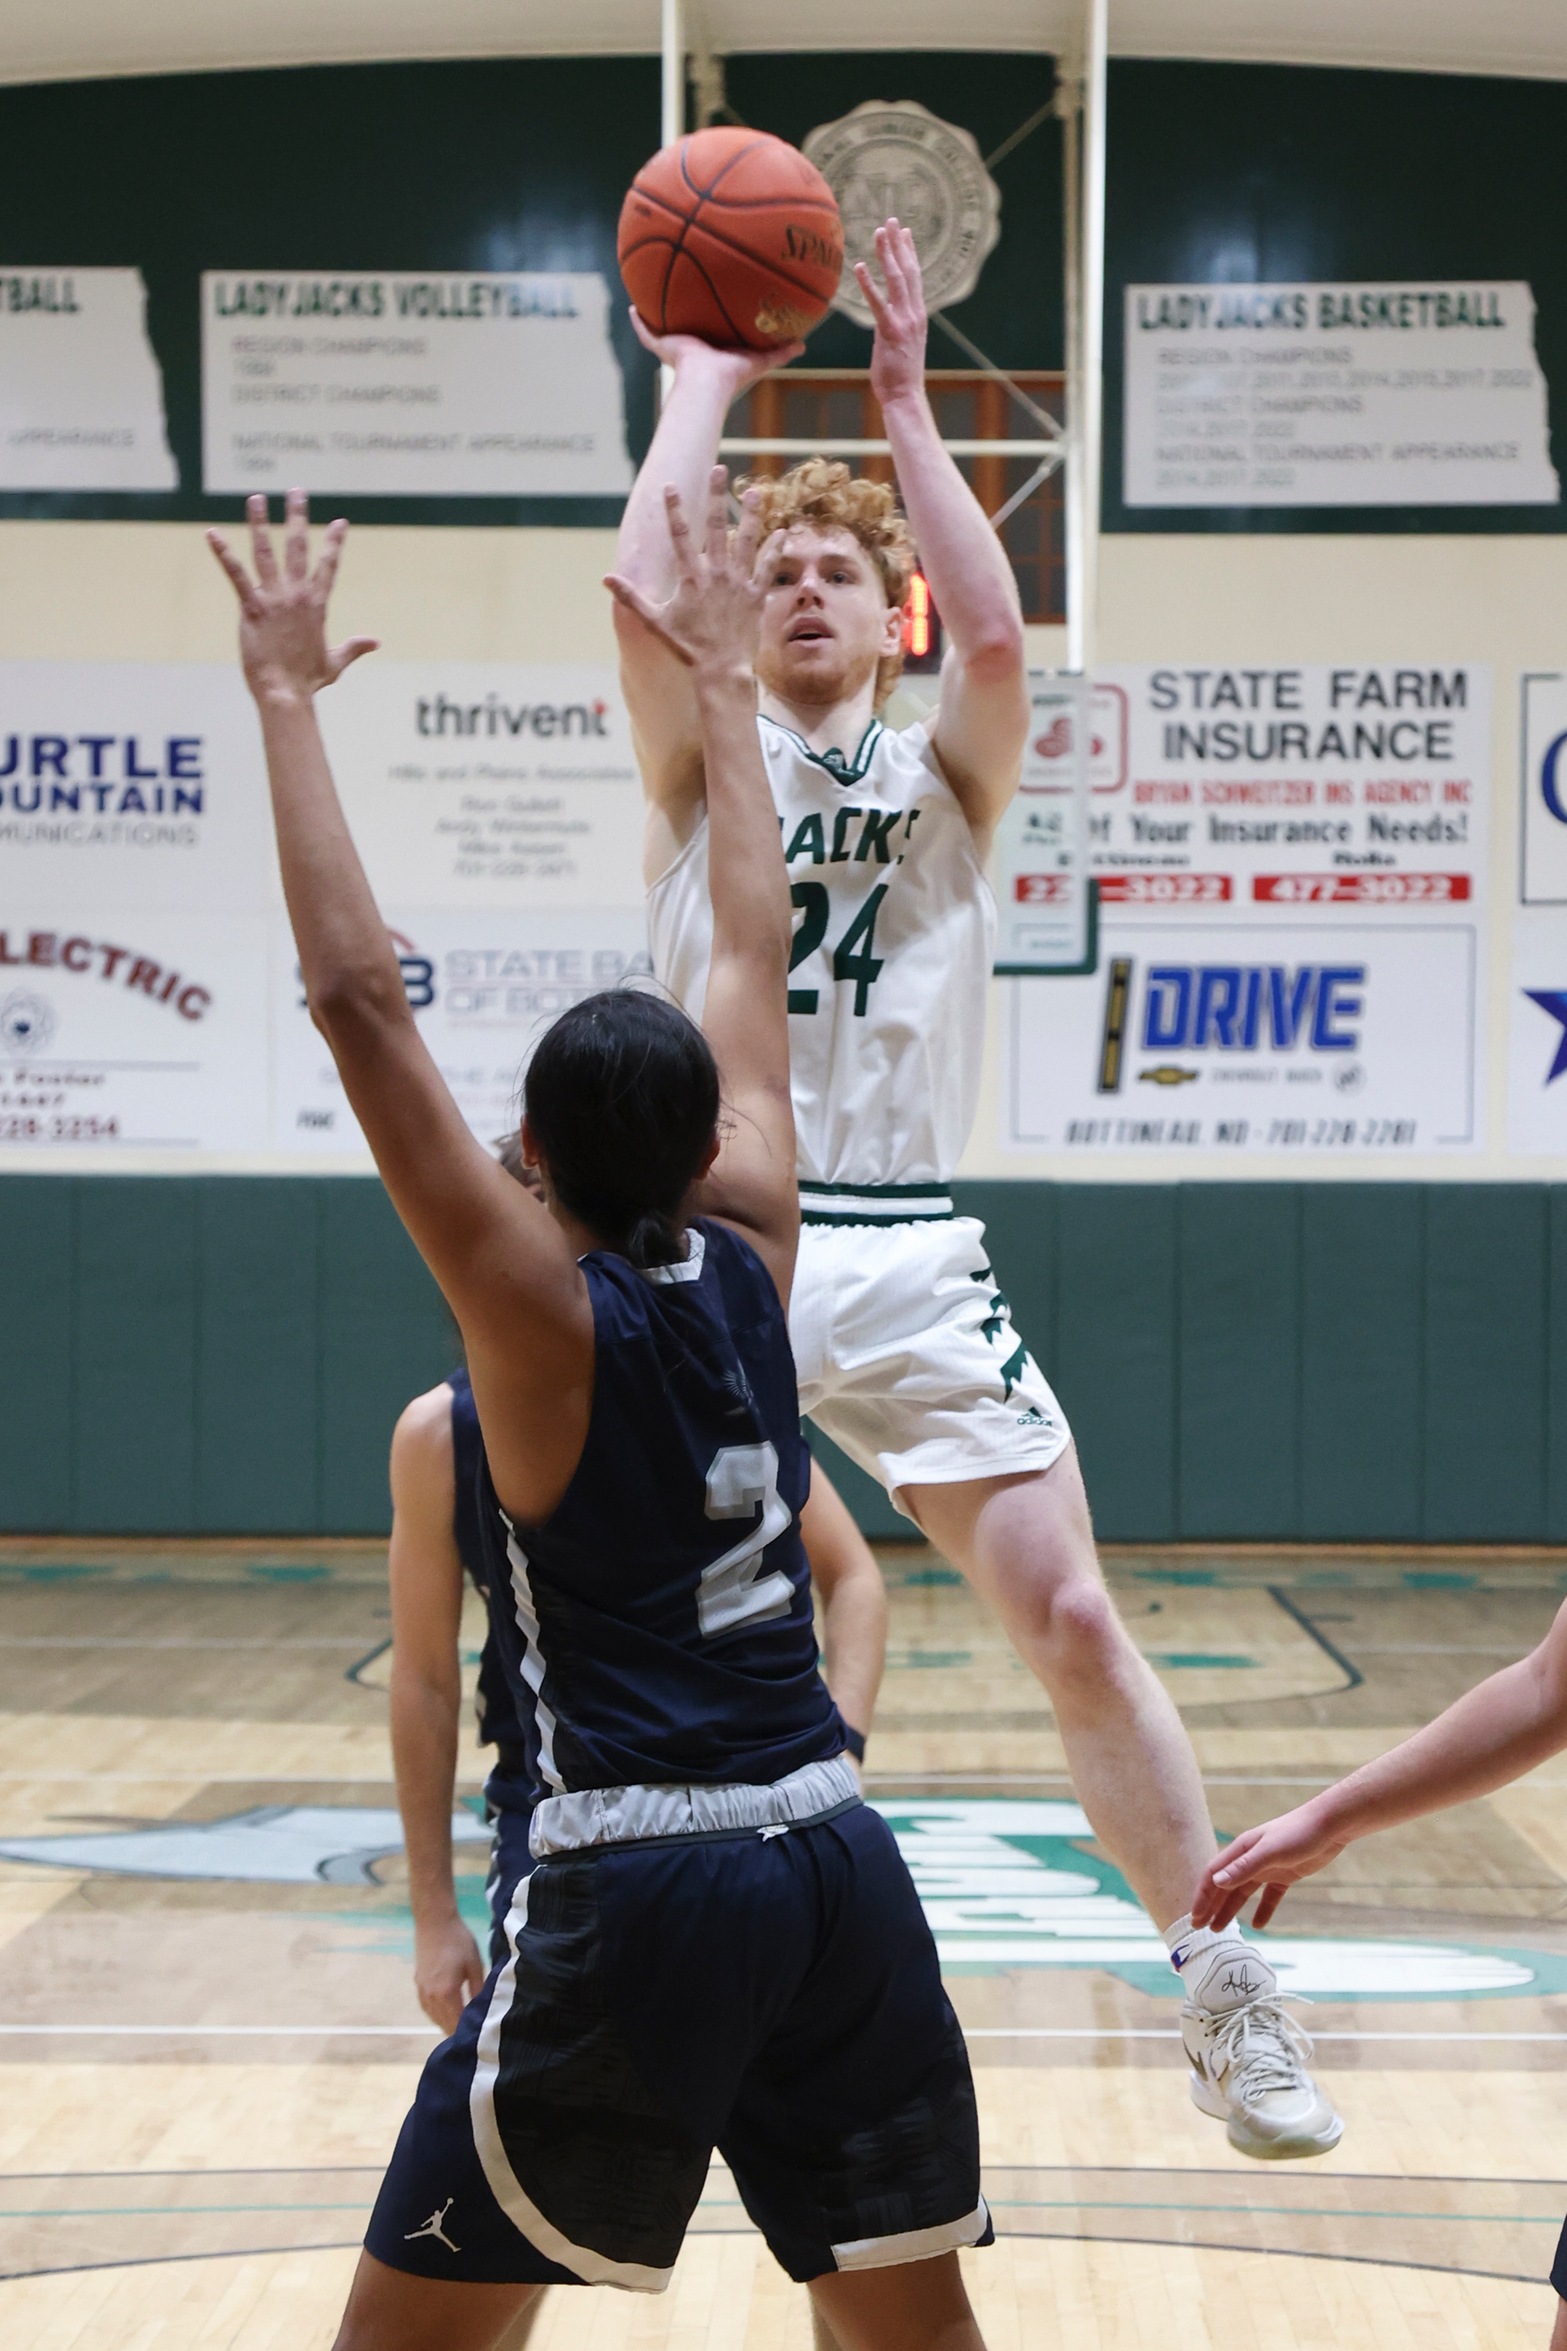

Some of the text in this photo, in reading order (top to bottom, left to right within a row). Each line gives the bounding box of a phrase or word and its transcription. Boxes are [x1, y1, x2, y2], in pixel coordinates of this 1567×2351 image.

[0, 276, 79, 313] BALL
[397, 279, 579, 317] VOLLEYBALL
[1317, 292, 1506, 329] BASKETBALL
[1150, 669, 1467, 710] STATE FARM
[416, 692, 607, 736] thrivent
[1164, 721, 1454, 761] INSURANCE
[0, 784, 204, 815] UNTAIN
[1365, 779, 1433, 804] AGENCY
[1444, 779, 1472, 804] INC
[777, 806, 921, 866] ACK
[1131, 814, 1190, 842] Your
[1208, 814, 1351, 843] Insurance
[1367, 812, 1469, 843] Needs!
[1268, 876, 1452, 902] 477-3022
[445, 950, 582, 979] STATE
[787, 881, 889, 1017] 24
[0, 930, 210, 1022] LECTRIC
[445, 987, 482, 1013] OF
[1140, 963, 1368, 1053] DRIVE
[695, 1440, 796, 1641] 2
